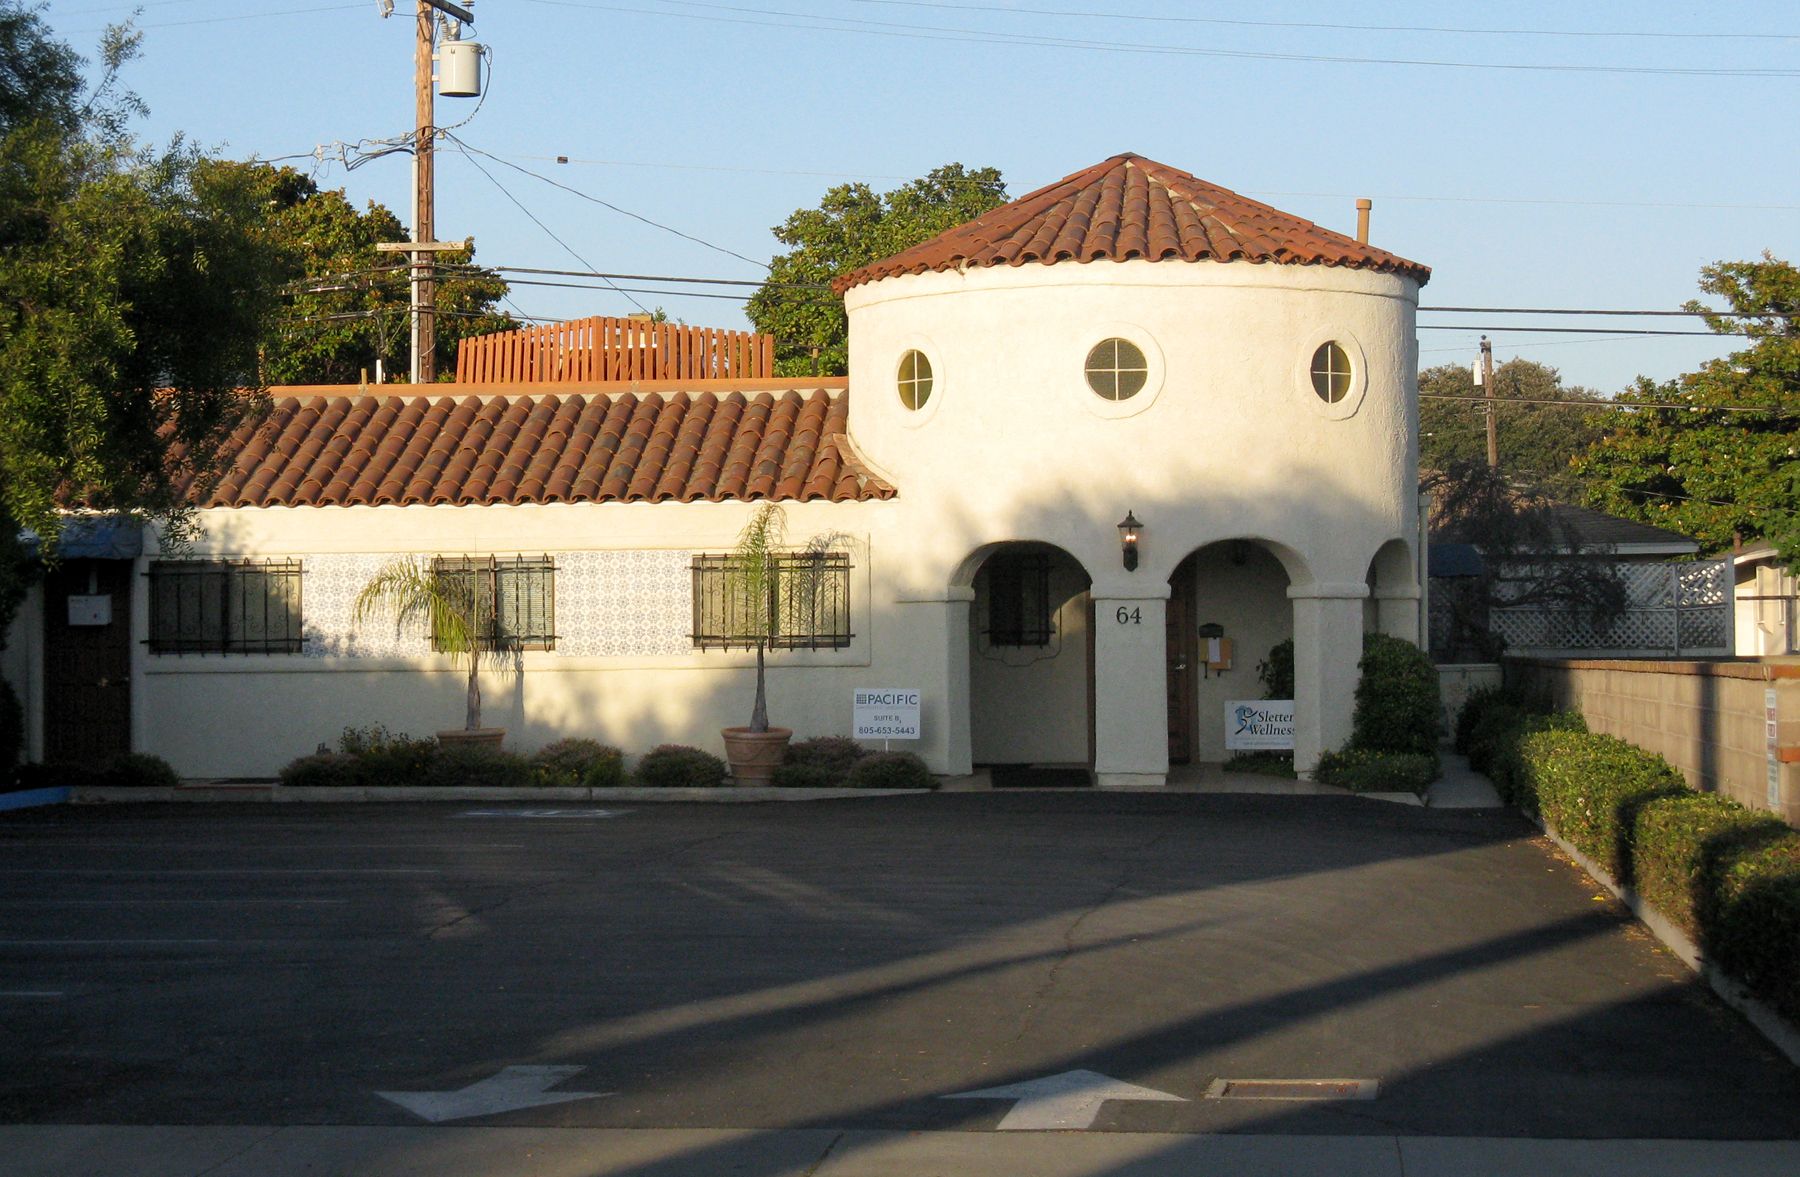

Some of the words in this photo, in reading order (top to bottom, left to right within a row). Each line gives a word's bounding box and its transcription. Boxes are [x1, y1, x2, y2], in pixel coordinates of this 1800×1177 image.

[1116, 606, 1142, 624] 64
[868, 694, 918, 705] PACIFIC
[858, 726, 915, 735] 805-653-5443
